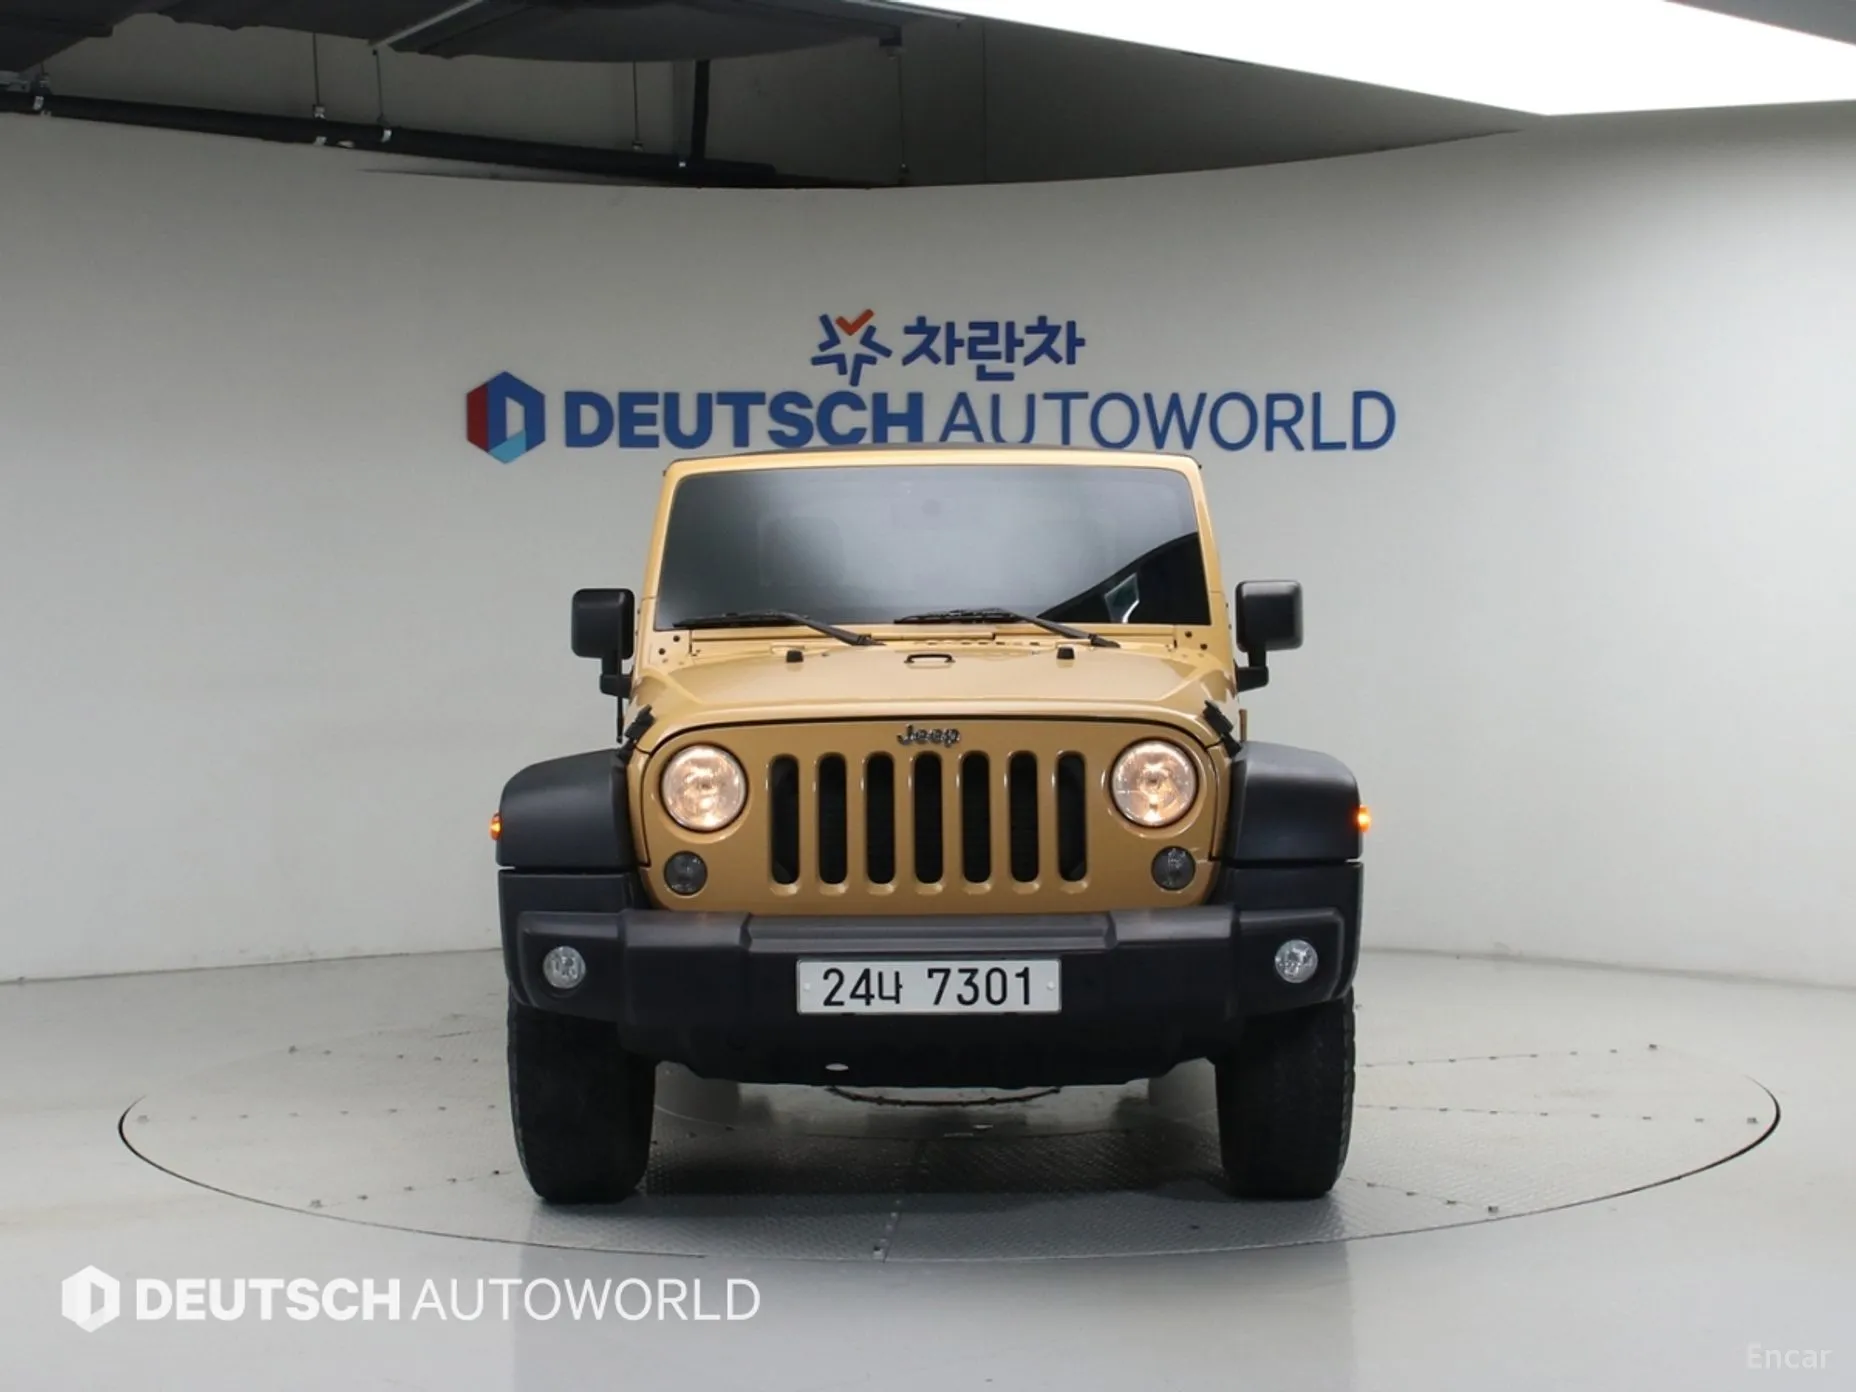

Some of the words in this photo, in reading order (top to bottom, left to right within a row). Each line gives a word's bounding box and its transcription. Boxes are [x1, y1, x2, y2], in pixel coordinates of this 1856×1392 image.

[902, 315, 1086, 381] 차란차
[564, 391, 924, 449] DEUTSCH
[939, 390, 1397, 452] AUTOWORLD
[896, 723, 960, 748] Jeep
[822, 967, 903, 1006] 24나
[926, 966, 1031, 1006] 7301
